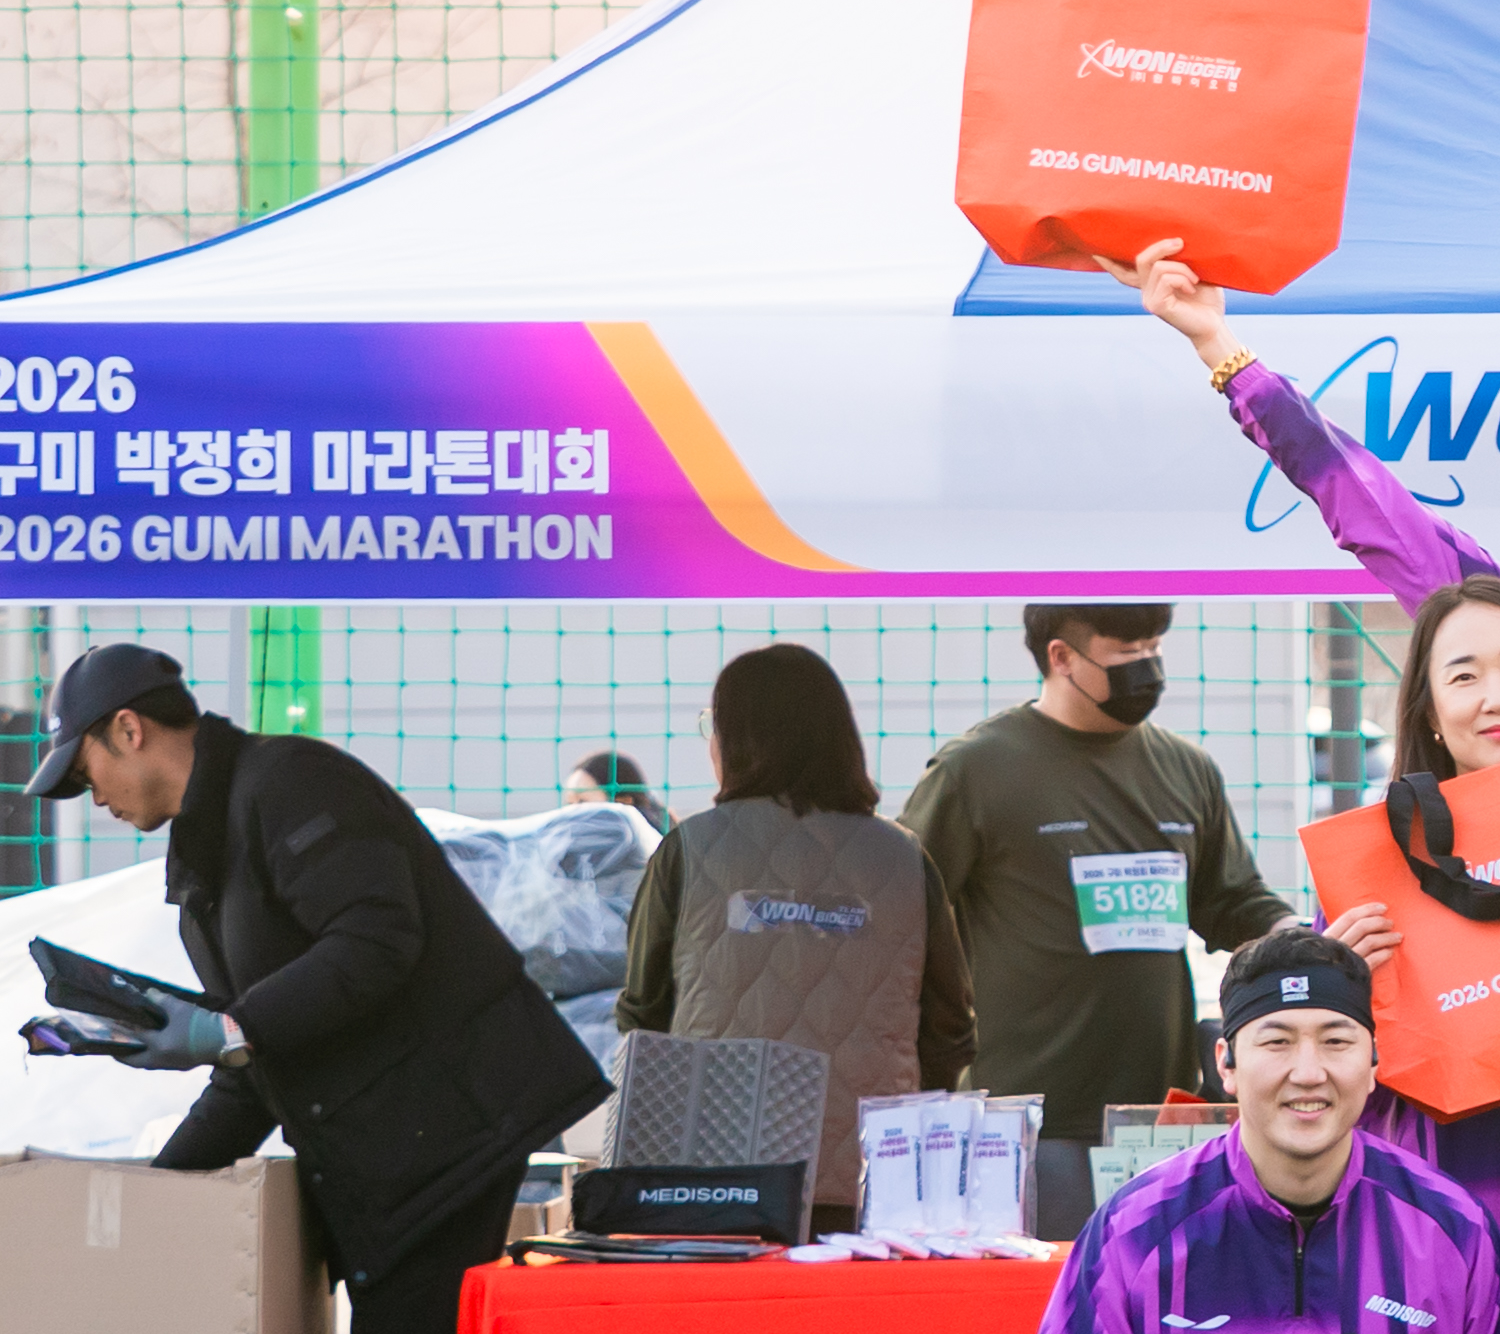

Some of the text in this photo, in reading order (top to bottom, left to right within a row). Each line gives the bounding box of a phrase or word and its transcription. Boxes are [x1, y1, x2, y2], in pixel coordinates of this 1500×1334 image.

[1103, 46, 1241, 80] WON BIOGEN
[1029, 148, 1272, 193] 2026 GUMI MARATHON
[0, 356, 136, 413] 2026
[117, 429, 292, 496] 박정희
[314, 429, 610, 496] 마라톤대회
[0, 514, 612, 562] 2026 GUMI MARATHON
[762, 902, 864, 927] WON BIOGEN
[1094, 884, 1179, 912] 51824
[1437, 980, 1490, 1012] 2026
[638, 1187, 759, 1204] MEDISORB
